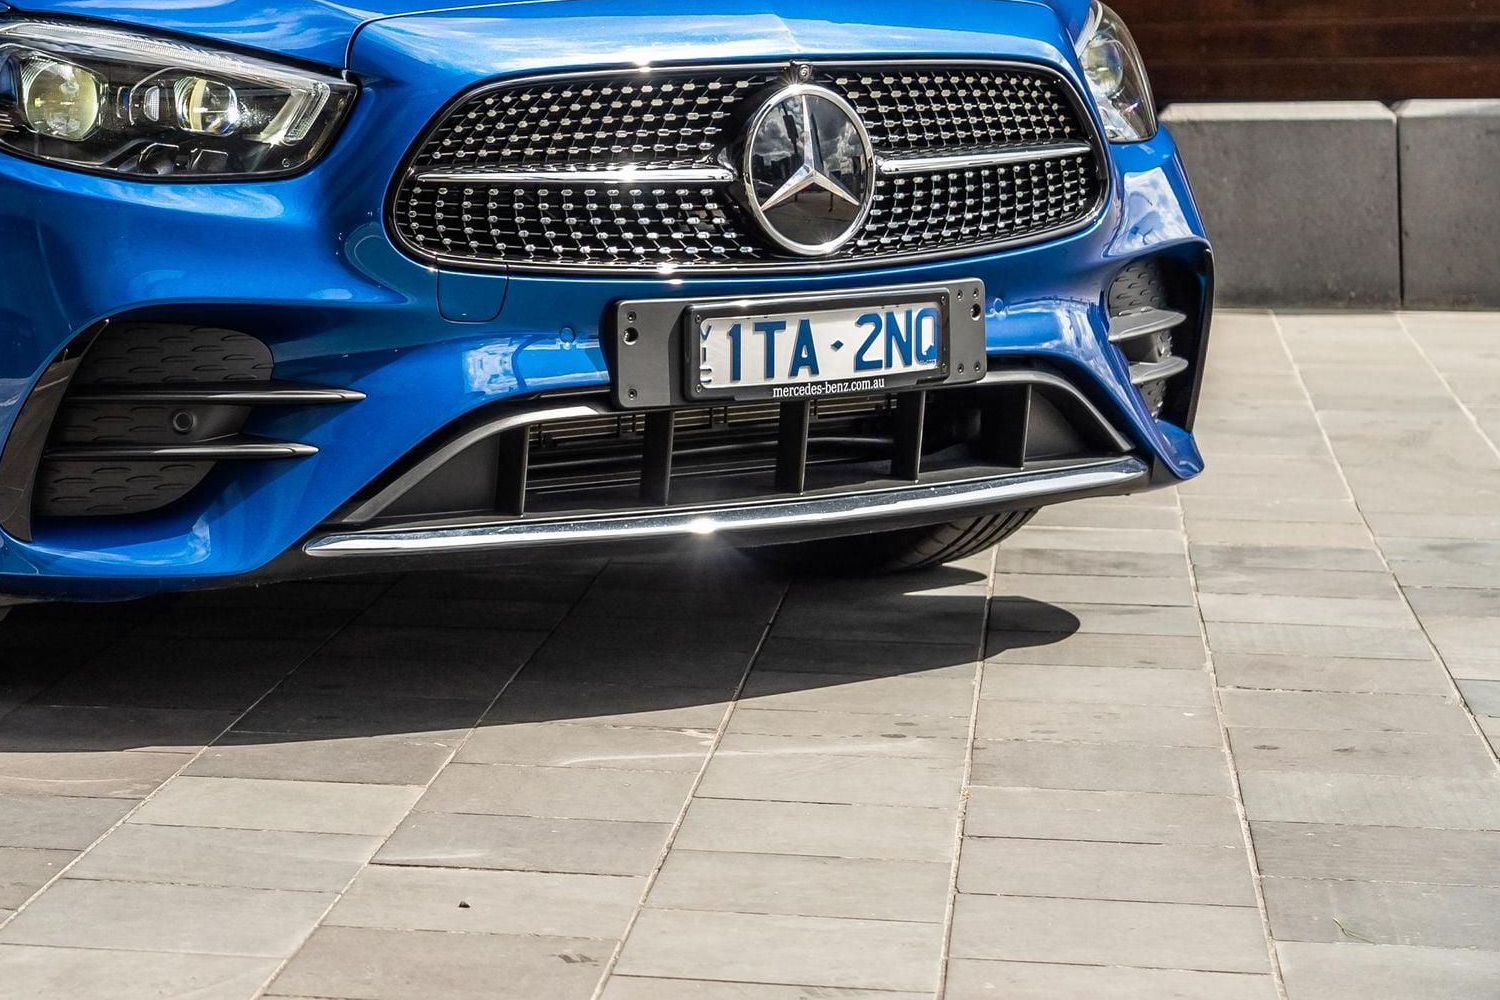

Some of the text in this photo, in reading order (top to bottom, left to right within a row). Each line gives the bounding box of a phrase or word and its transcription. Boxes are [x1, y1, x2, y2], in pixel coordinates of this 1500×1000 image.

[728, 308, 939, 382] 1TA 2NQ
[772, 378, 885, 398] mercedes-benz.com.au
